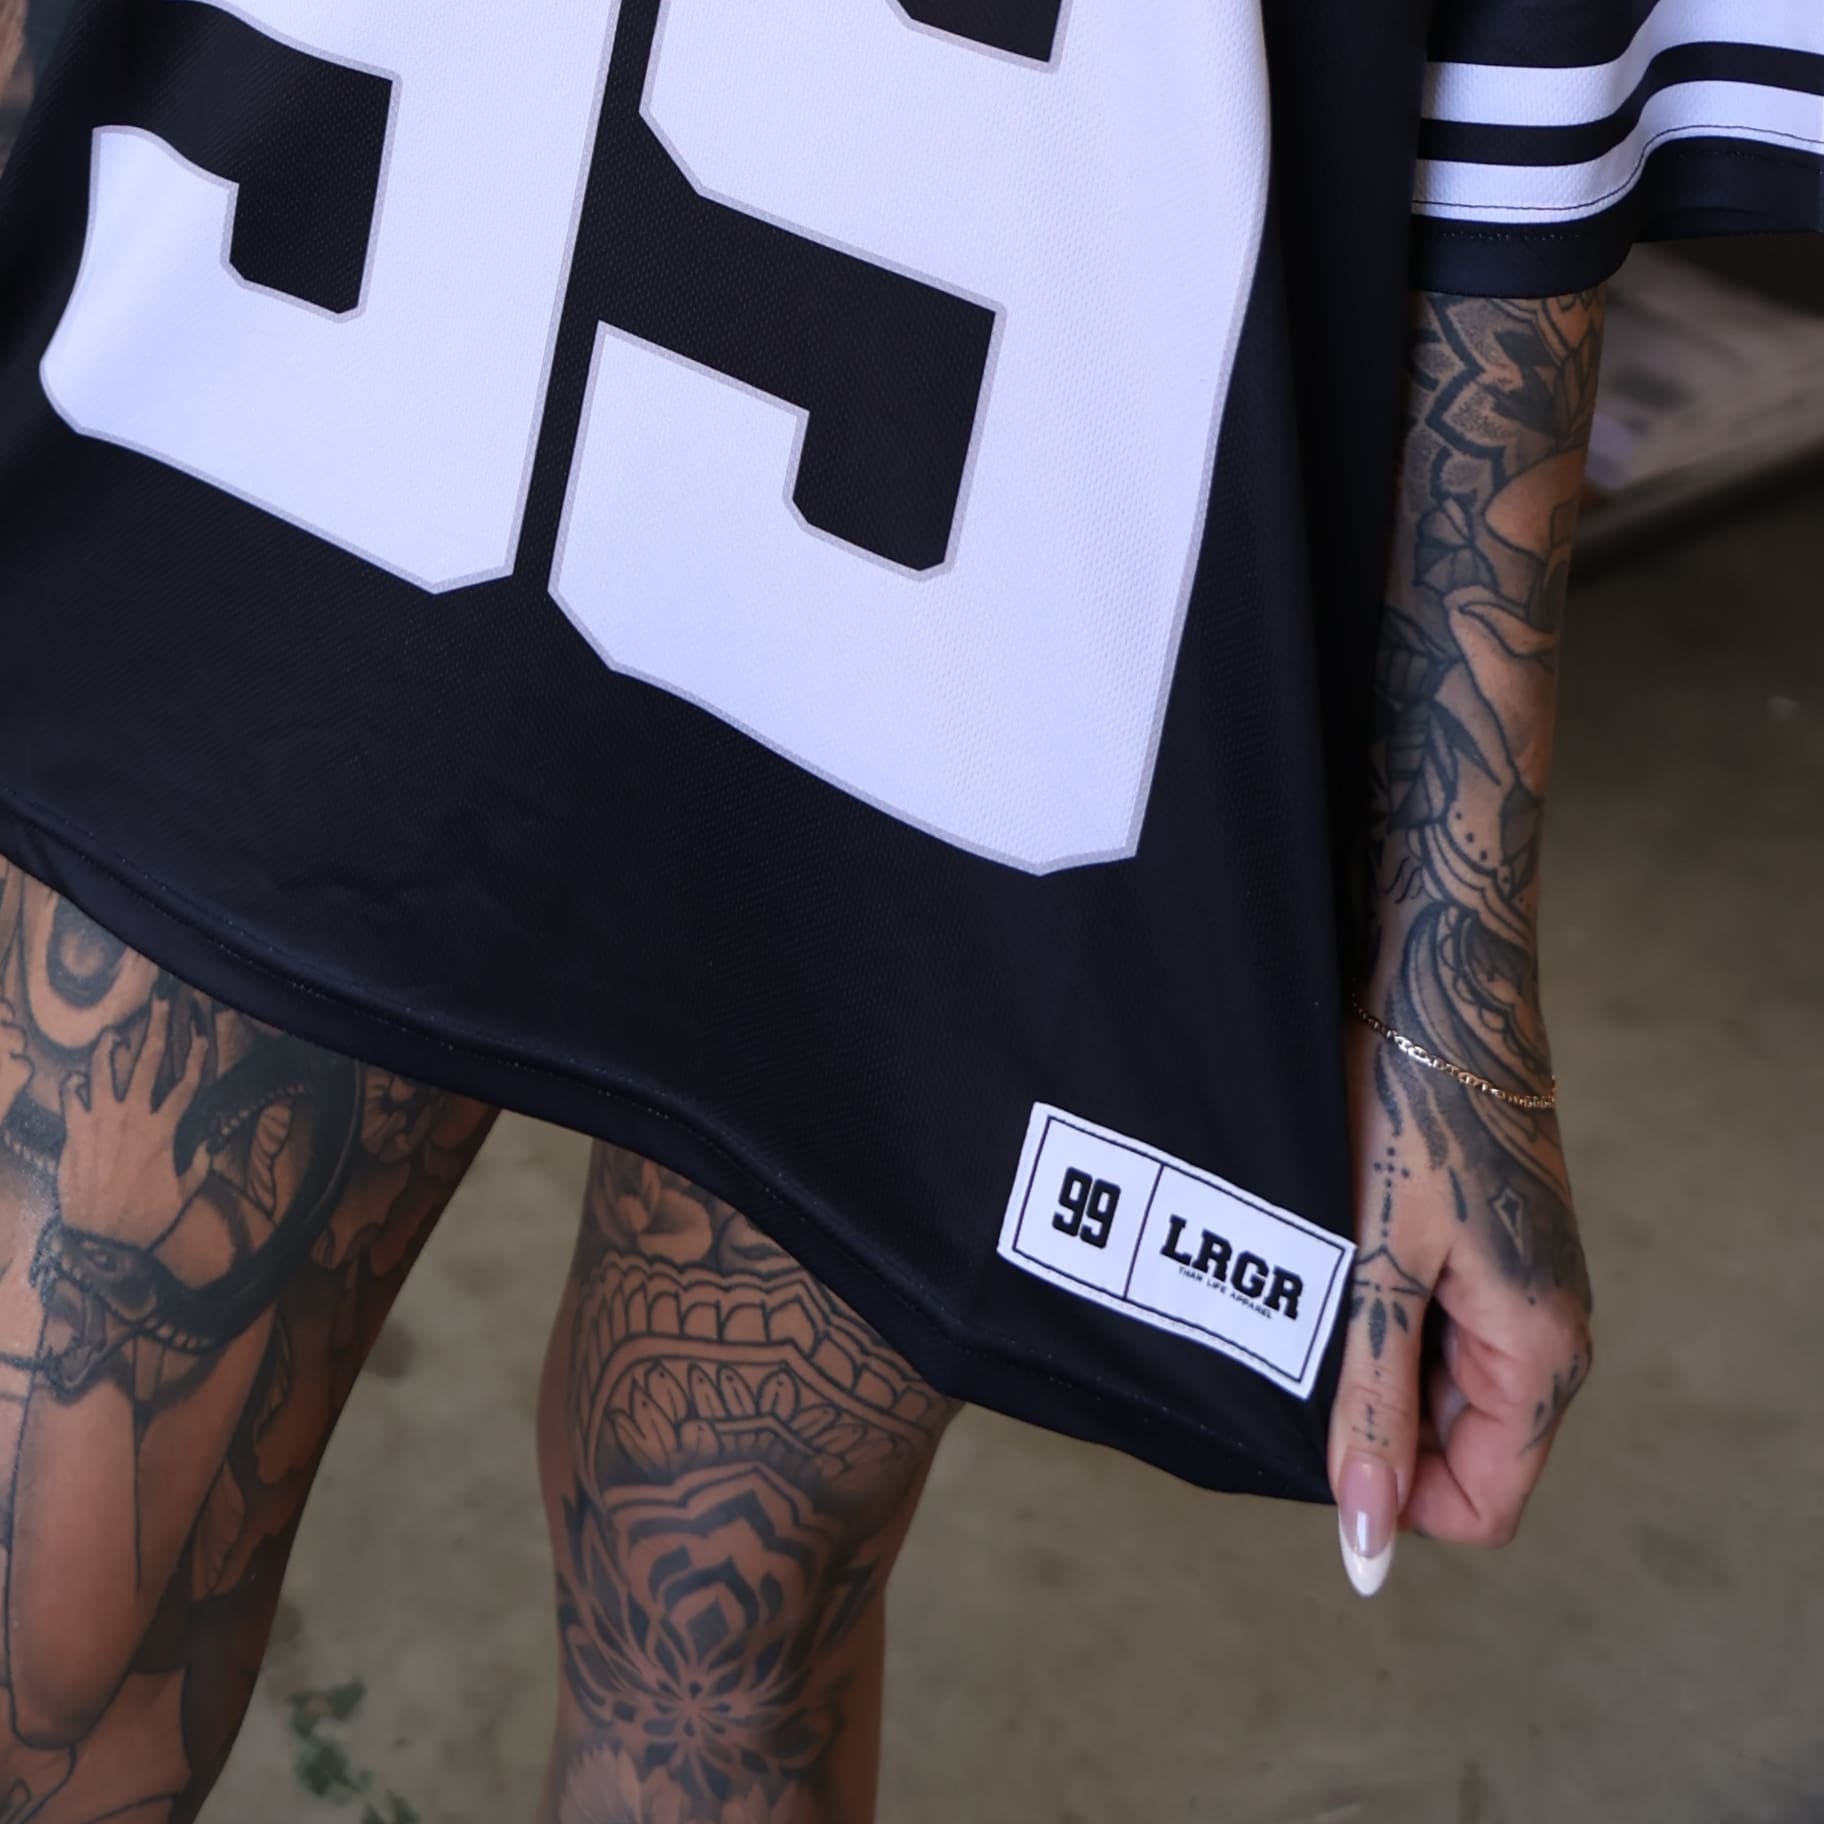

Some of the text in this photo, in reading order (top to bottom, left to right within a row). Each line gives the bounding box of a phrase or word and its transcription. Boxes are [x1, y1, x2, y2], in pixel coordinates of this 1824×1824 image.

[1051, 1166, 1121, 1250] 99
[1160, 1213, 1304, 1321] LRGR
[1178, 1266, 1203, 1282] THAN
[1207, 1279, 1228, 1295] LIFE
